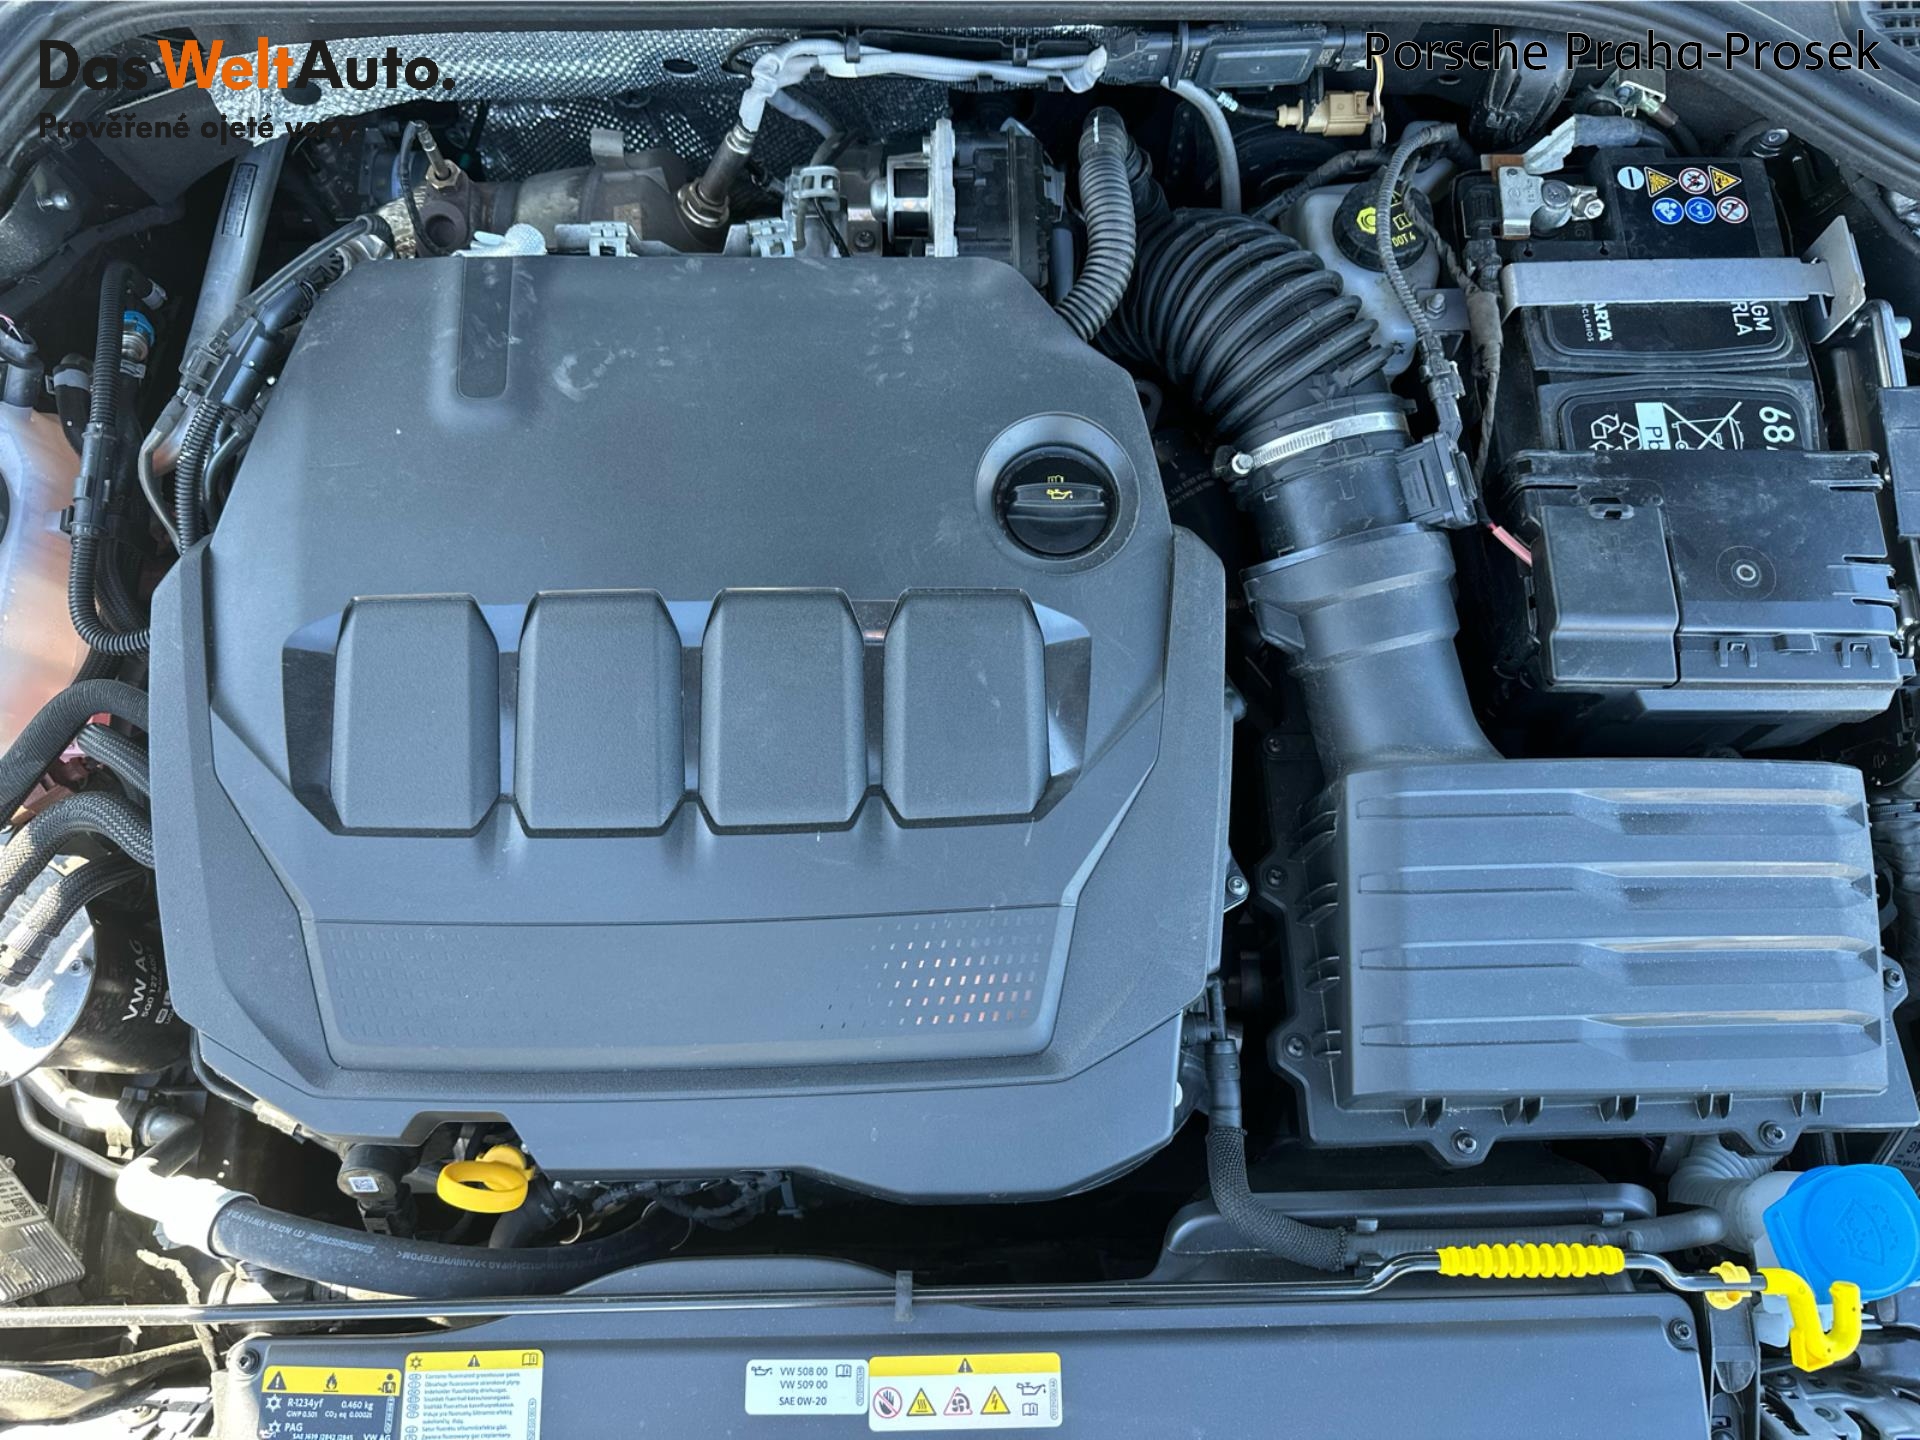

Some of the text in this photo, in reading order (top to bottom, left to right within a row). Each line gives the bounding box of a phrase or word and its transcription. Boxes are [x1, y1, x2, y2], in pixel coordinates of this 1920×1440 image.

[1391, 231, 1416, 247] DOT 4
[1581, 308, 1594, 342] CLARIOS
[1594, 302, 1612, 342] ARTA
[1645, 426, 1664, 450] Pb
[122, 977, 147, 1020] VW
[780, 1367, 828, 1376] VW 508 00
[780, 1380, 828, 1389] VW 509 00
[287, 1398, 374, 1411] R-1234yf 0.460 kg
[779, 1396, 827, 1406] SAE 0W-20
[284, 1422, 304, 1432] PAG
